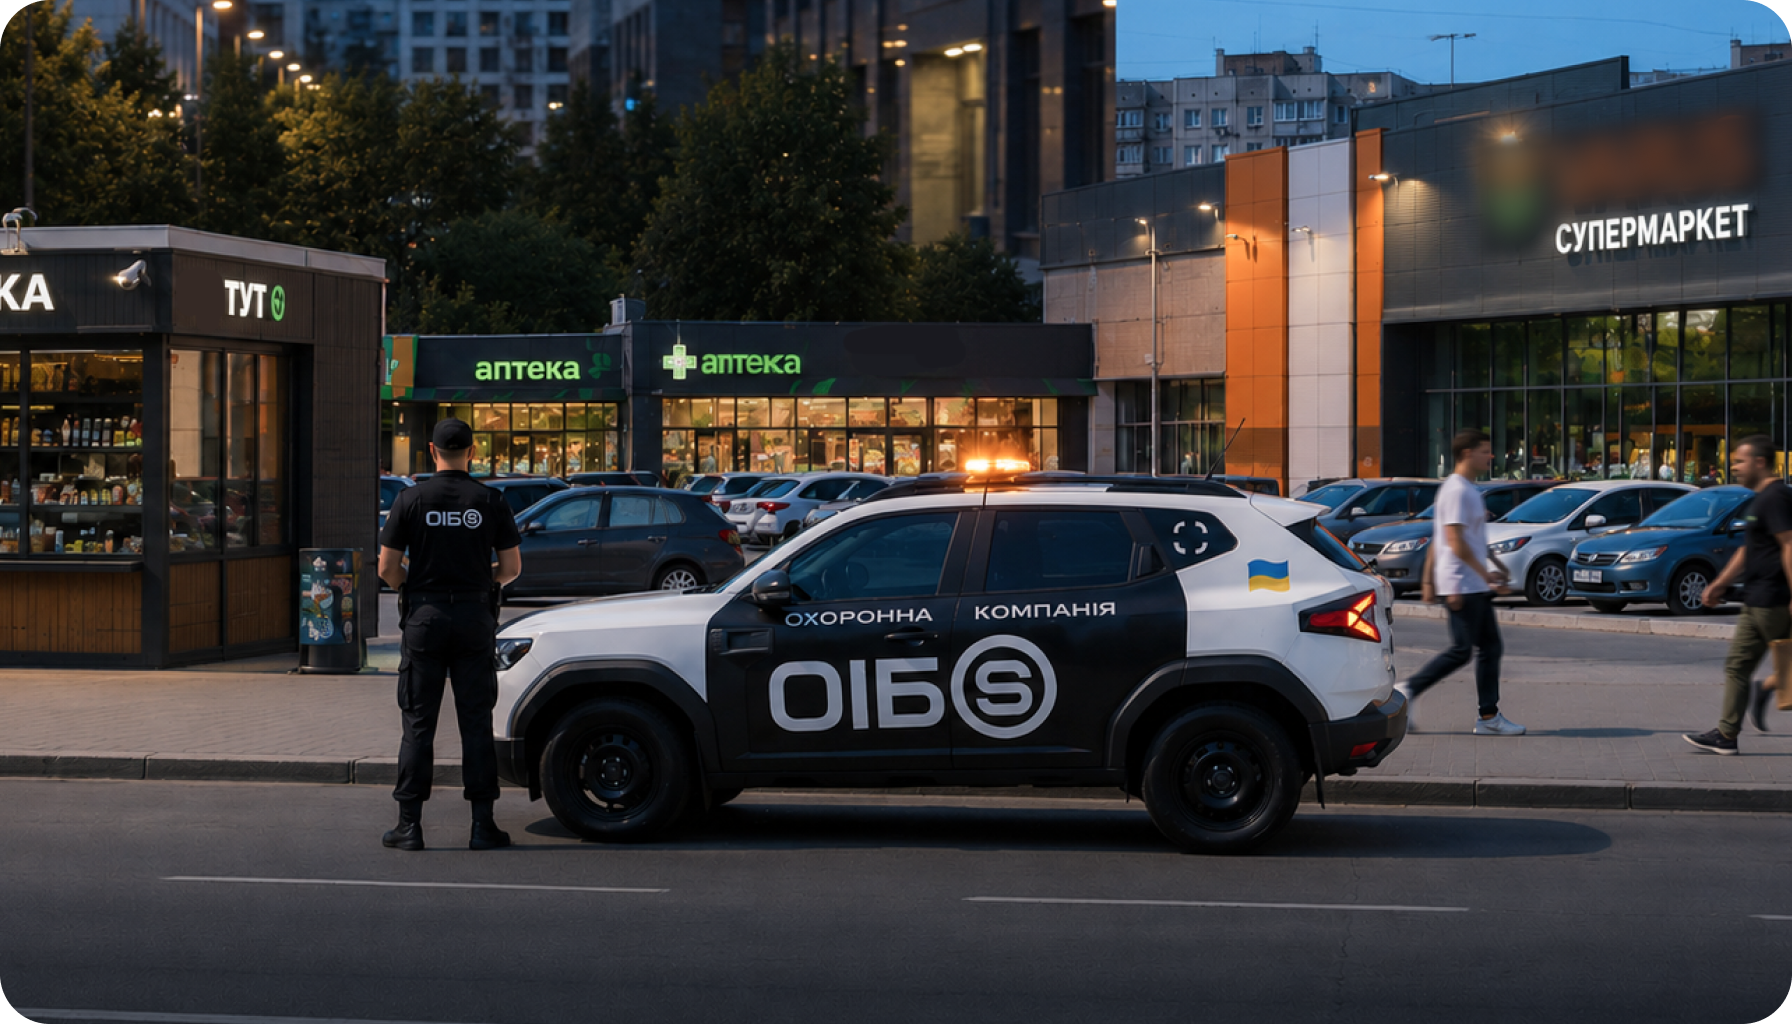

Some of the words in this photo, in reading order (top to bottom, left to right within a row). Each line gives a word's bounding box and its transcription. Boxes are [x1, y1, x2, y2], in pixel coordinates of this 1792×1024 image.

[1555, 203, 1750, 254] СУПЕРМАРКЕТ
[0, 273, 55, 311] КА
[224, 279, 268, 319] ТУТ
[475, 360, 581, 381] аптека
[701, 353, 801, 375] аптека
[785, 607, 933, 627] ОХОРОННА
[974, 601, 1117, 620] КОМПАНІЯ
